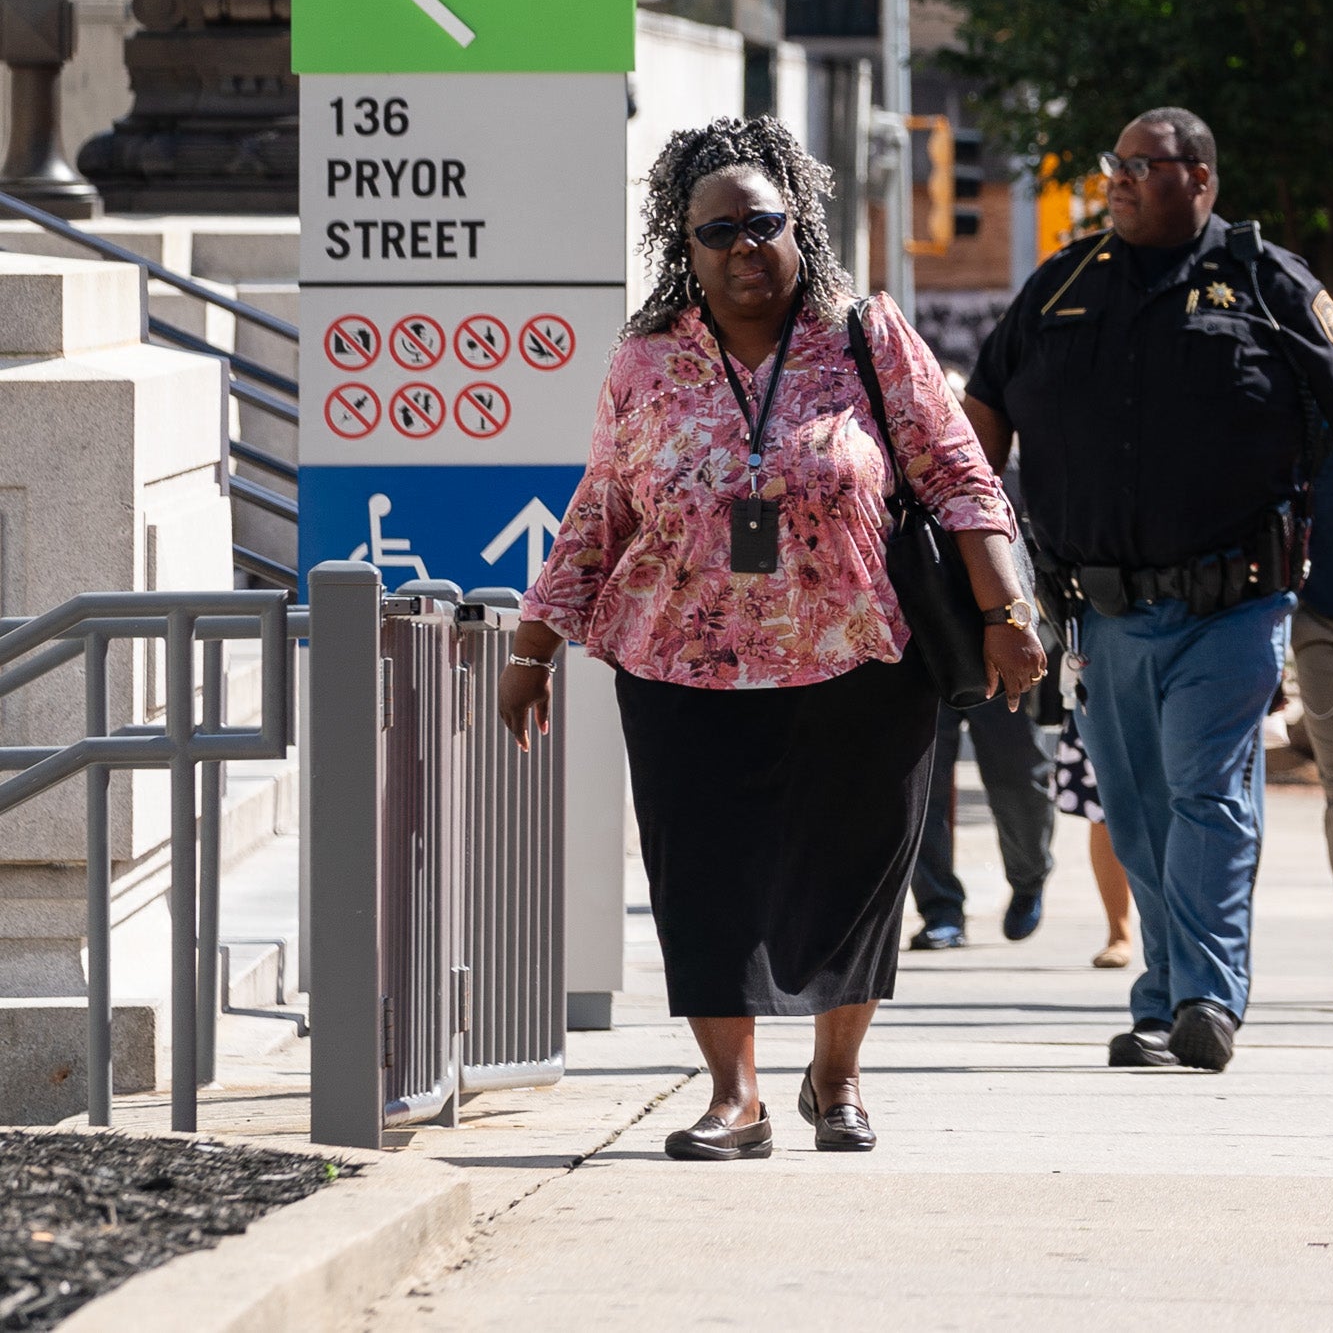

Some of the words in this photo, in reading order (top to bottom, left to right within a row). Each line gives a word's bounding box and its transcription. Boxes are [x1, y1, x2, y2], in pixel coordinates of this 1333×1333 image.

[329, 97, 410, 137] 136
[327, 158, 466, 198] PRYOR
[325, 219, 486, 261] STREET
